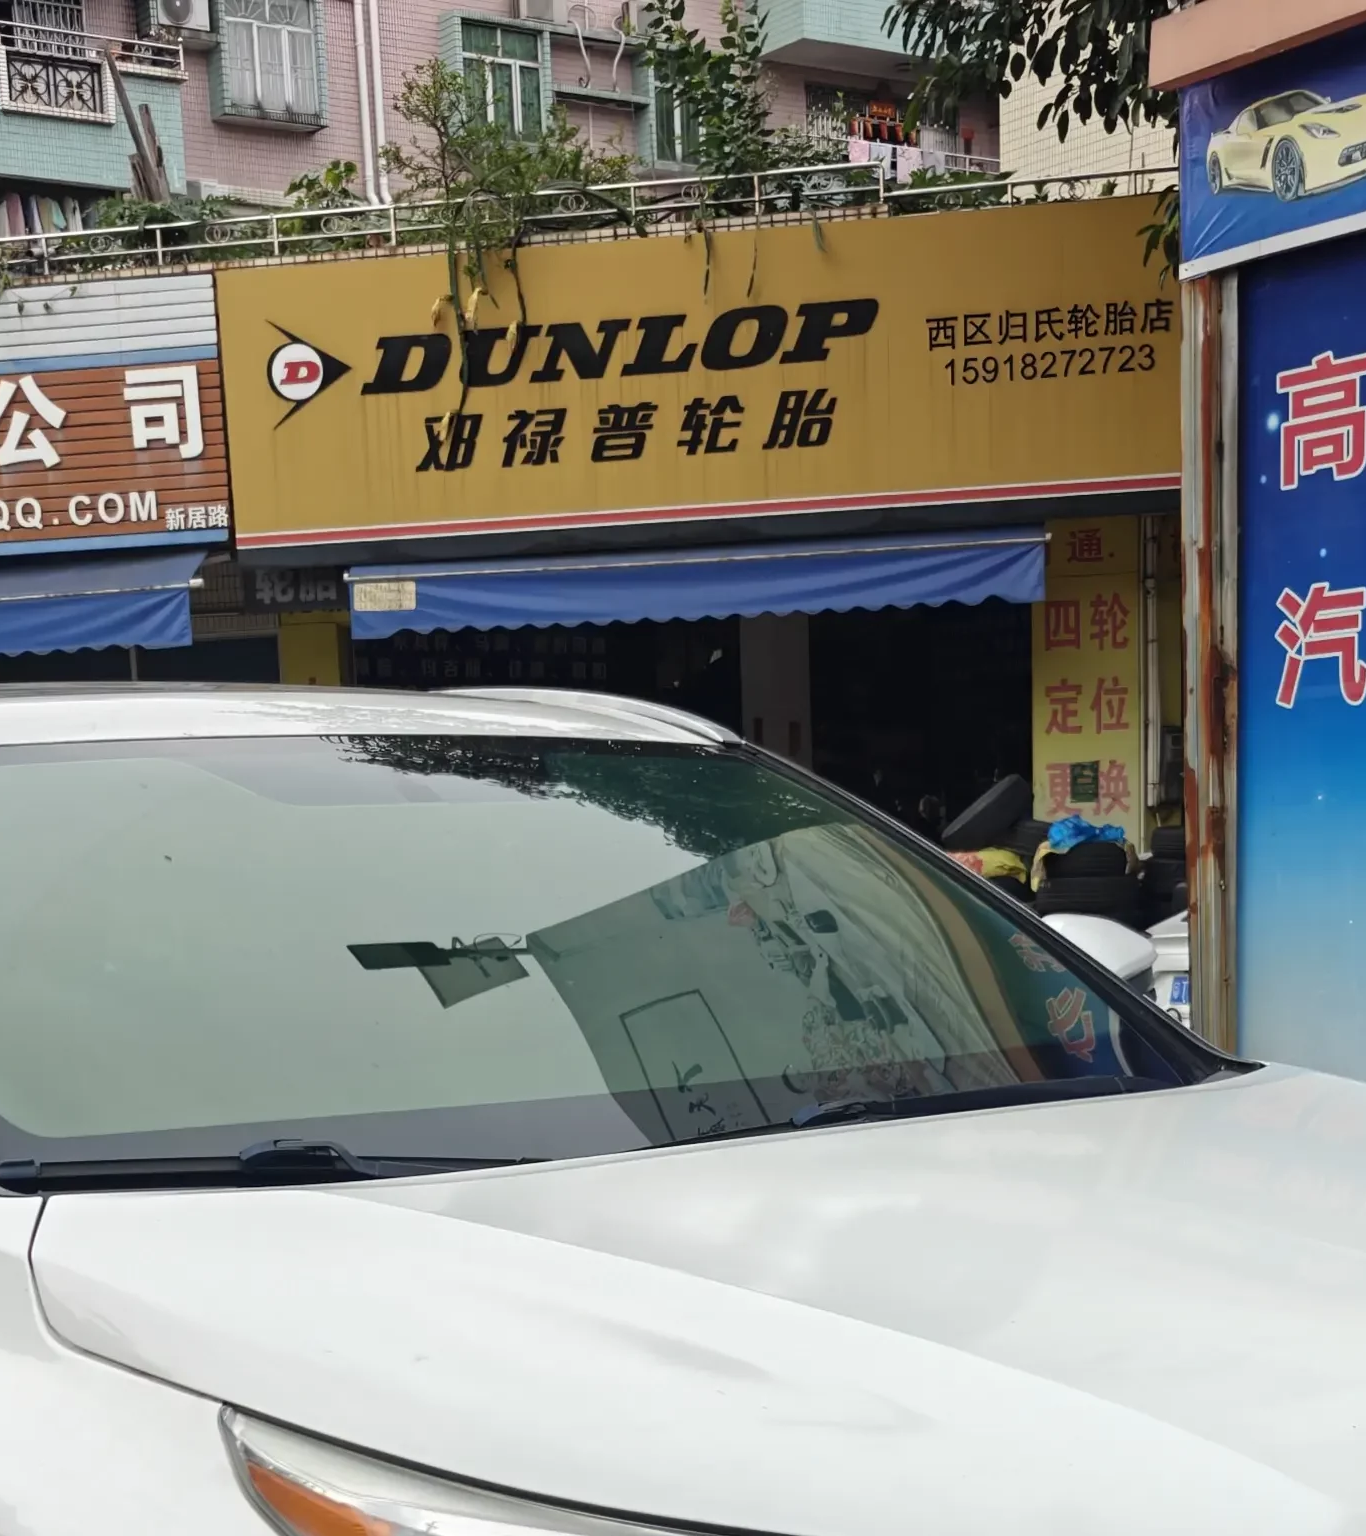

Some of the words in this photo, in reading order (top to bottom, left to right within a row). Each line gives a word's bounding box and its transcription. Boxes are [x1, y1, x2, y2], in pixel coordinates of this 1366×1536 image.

[360, 298, 880, 396] DUNLOP
[926, 299, 1174, 351] 西区归氏轮胎店
[280, 362, 321, 386] D
[944, 343, 1155, 386] 15918272723
[415, 388, 838, 473] 邓禄普轮胎
[165, 504, 230, 531] 新居路
[1044, 592, 1131, 652] 四轮
[1044, 677, 1130, 735] 定位
